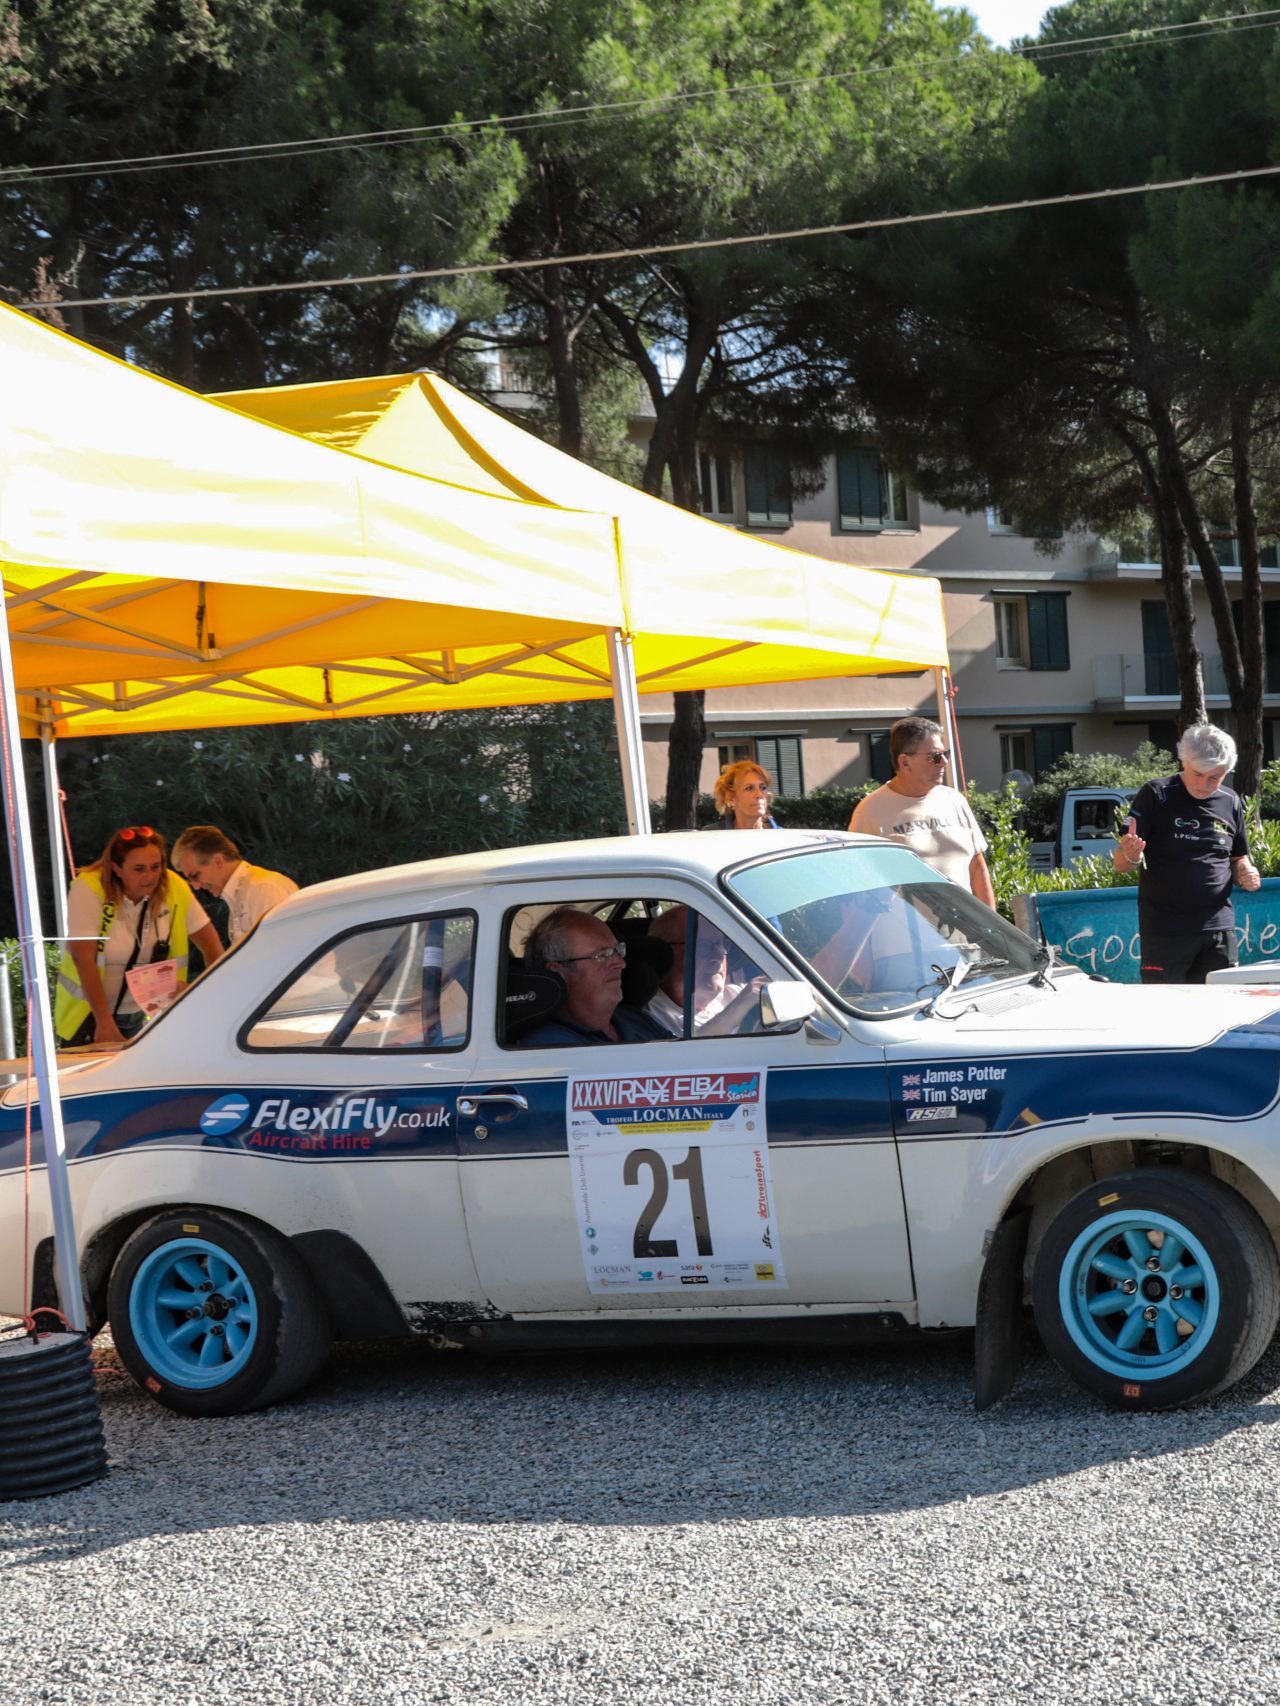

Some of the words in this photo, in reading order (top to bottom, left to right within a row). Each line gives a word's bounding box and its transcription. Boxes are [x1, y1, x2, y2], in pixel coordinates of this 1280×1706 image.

[922, 1068, 964, 1084] James
[967, 1066, 1008, 1081] Potter
[573, 1080, 618, 1108] XXXVI
[674, 1076, 726, 1101] ELBA
[922, 1087, 947, 1103] Tim
[950, 1086, 988, 1104] Sayer
[606, 1116, 633, 1125] TROFEO
[632, 1107, 704, 1123] LOCMAN
[704, 1112, 725, 1120] ITALY
[249, 1131, 327, 1150] Aircraft
[332, 1134, 373, 1150] Hire
[623, 1146, 714, 1259] 21
[593, 1264, 632, 1275] LOCMAN
